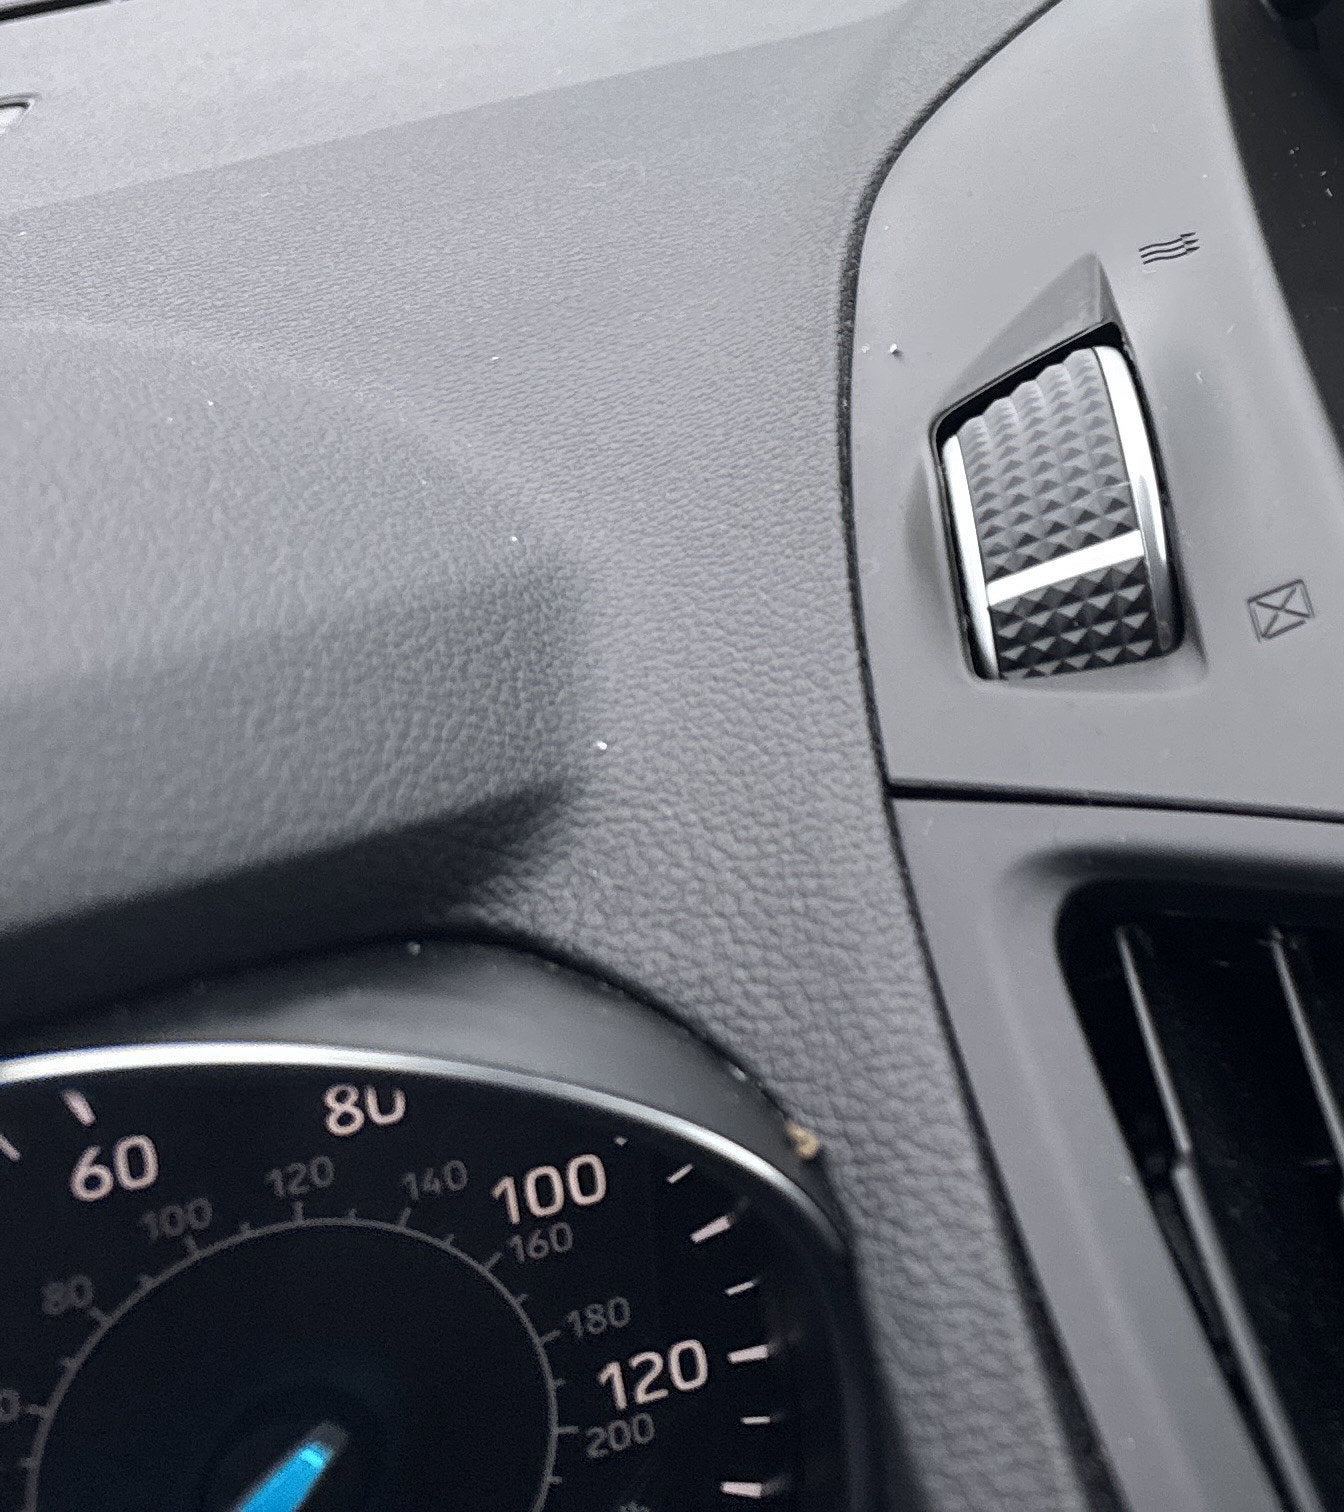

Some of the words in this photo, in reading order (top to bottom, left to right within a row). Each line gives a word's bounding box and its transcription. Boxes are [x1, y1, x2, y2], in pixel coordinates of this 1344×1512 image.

[322, 1084, 406, 1137] 80
[70, 1135, 159, 1202] 60
[264, 1156, 335, 1197] 120
[401, 1160, 468, 1201] 140
[490, 1154, 606, 1224] 100
[139, 1198, 213, 1242] 100
[510, 1222, 573, 1262] 160
[41, 1275, 94, 1315] 80
[566, 1297, 631, 1337] 180
[599, 1339, 708, 1410] 120
[586, 1413, 654, 1458] 200
